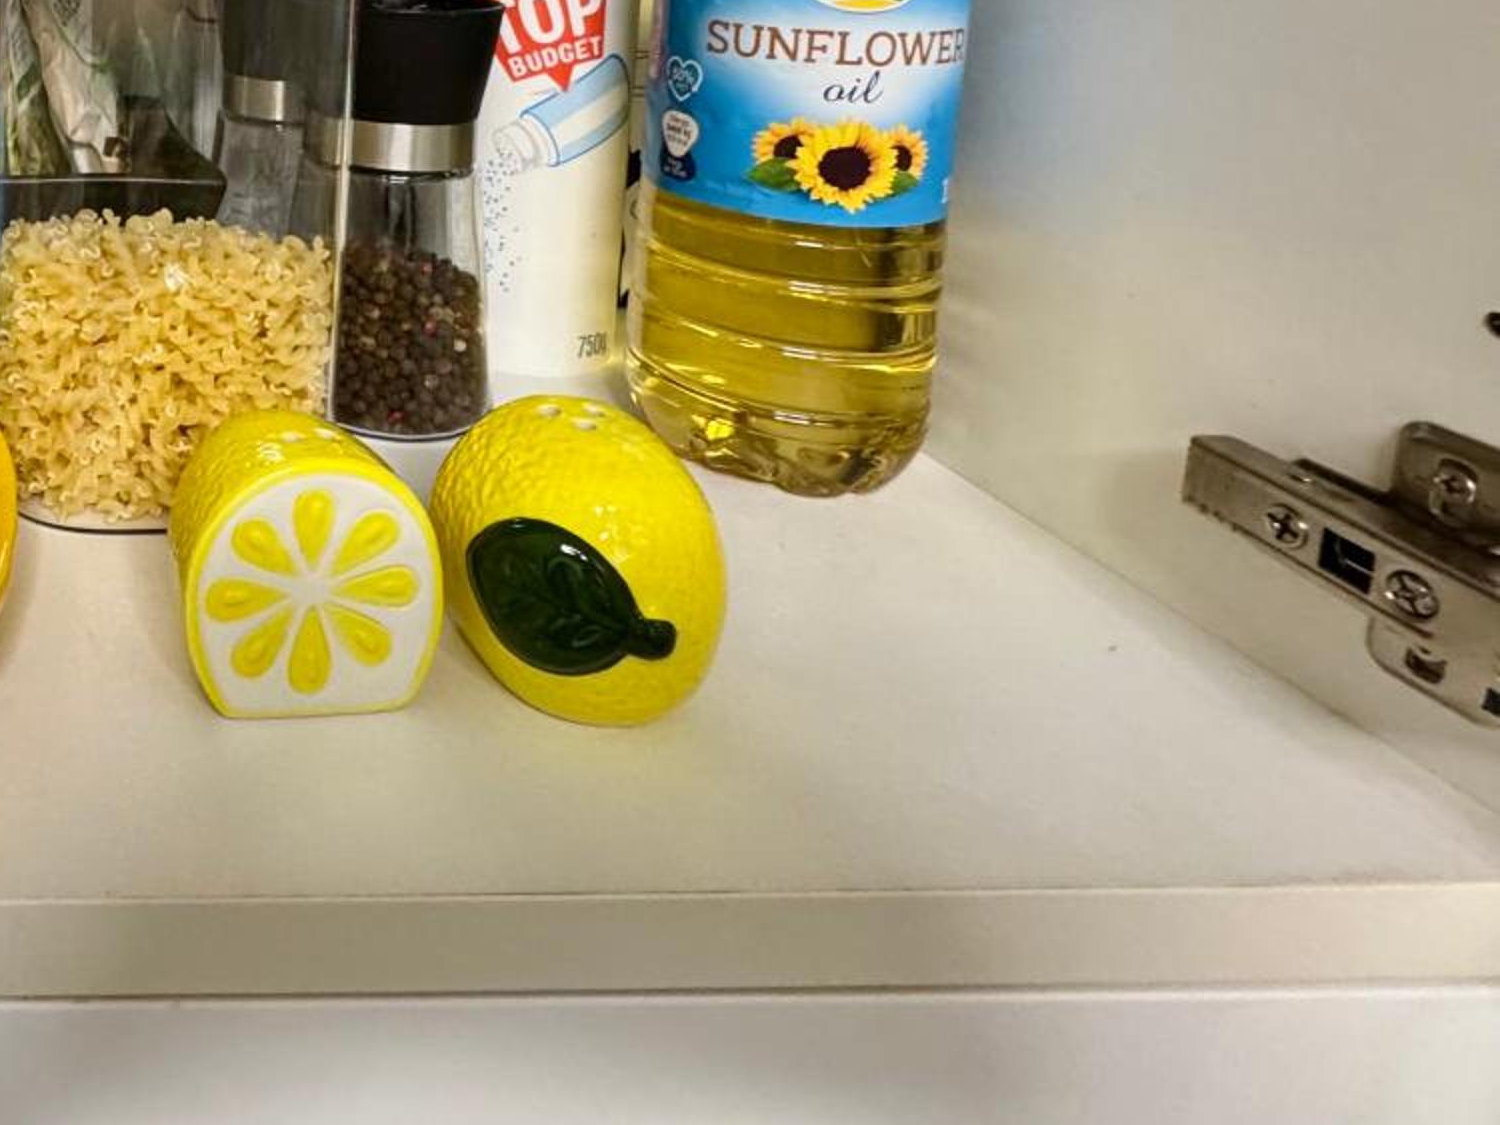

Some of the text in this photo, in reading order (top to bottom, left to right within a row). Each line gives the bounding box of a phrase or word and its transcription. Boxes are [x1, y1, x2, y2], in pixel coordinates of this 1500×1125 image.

[508, 36, 603, 77] BUDGET
[707, 19, 965, 67] SUNFLOWER
[823, 69, 884, 104] oil
